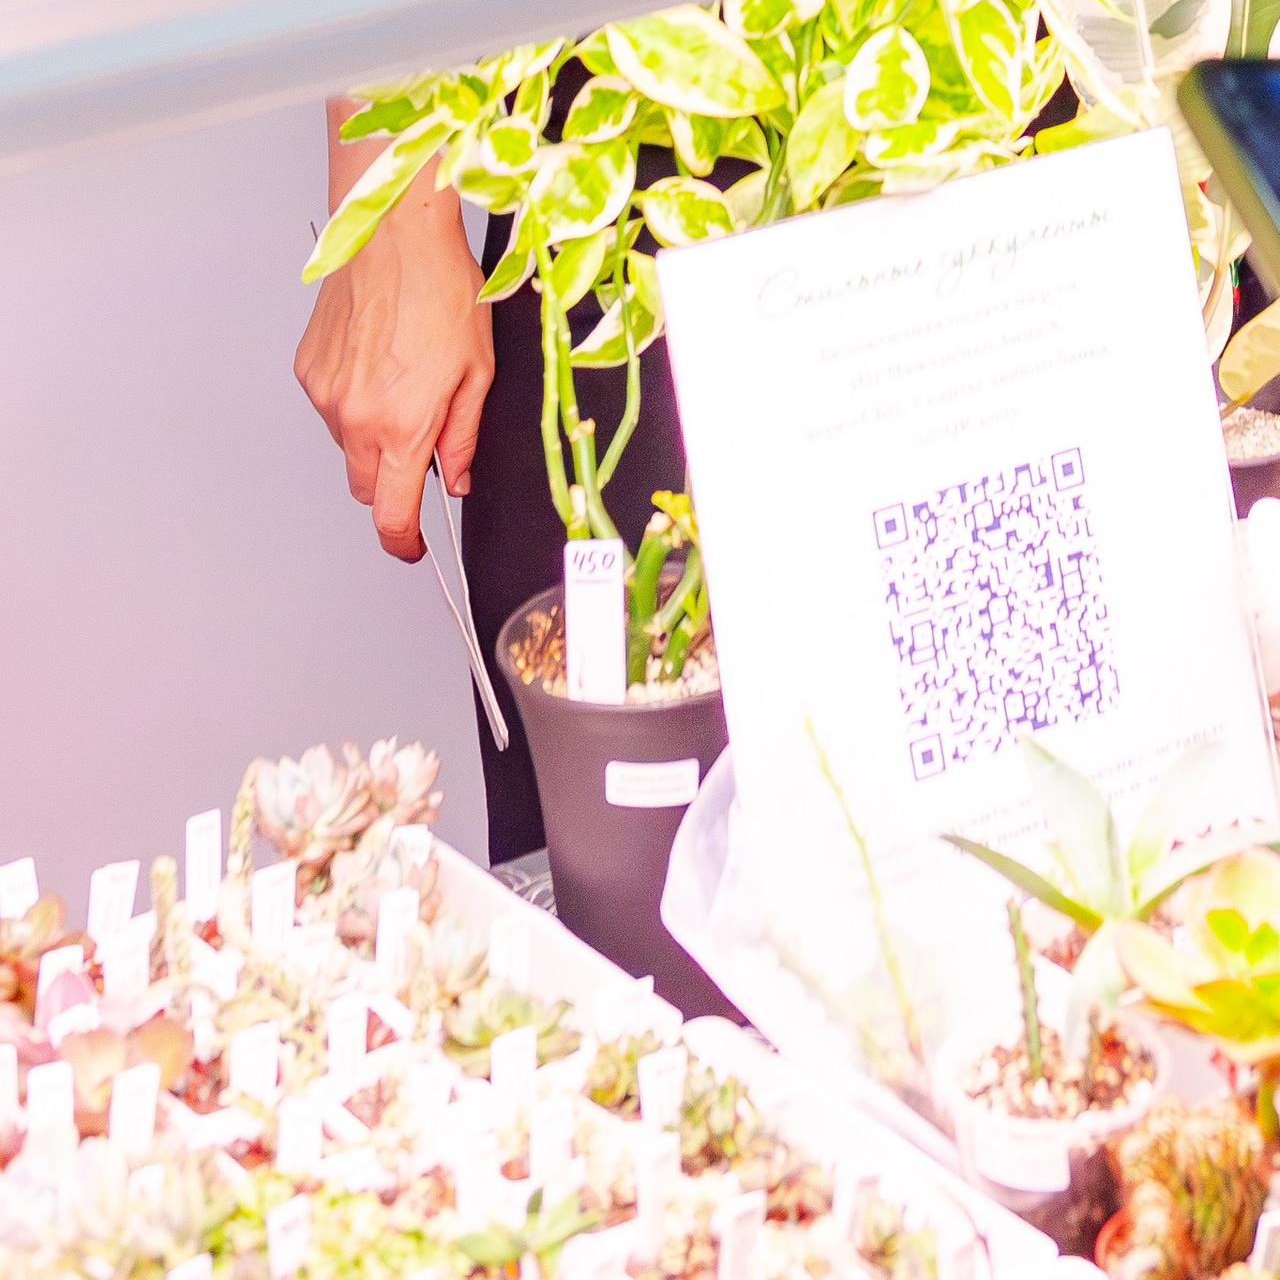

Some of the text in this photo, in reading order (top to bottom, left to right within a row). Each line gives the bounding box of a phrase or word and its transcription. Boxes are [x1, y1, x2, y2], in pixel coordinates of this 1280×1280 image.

[756, 210, 1113, 318] Стильные суккуленты
[573, 551, 616, 574] 450
